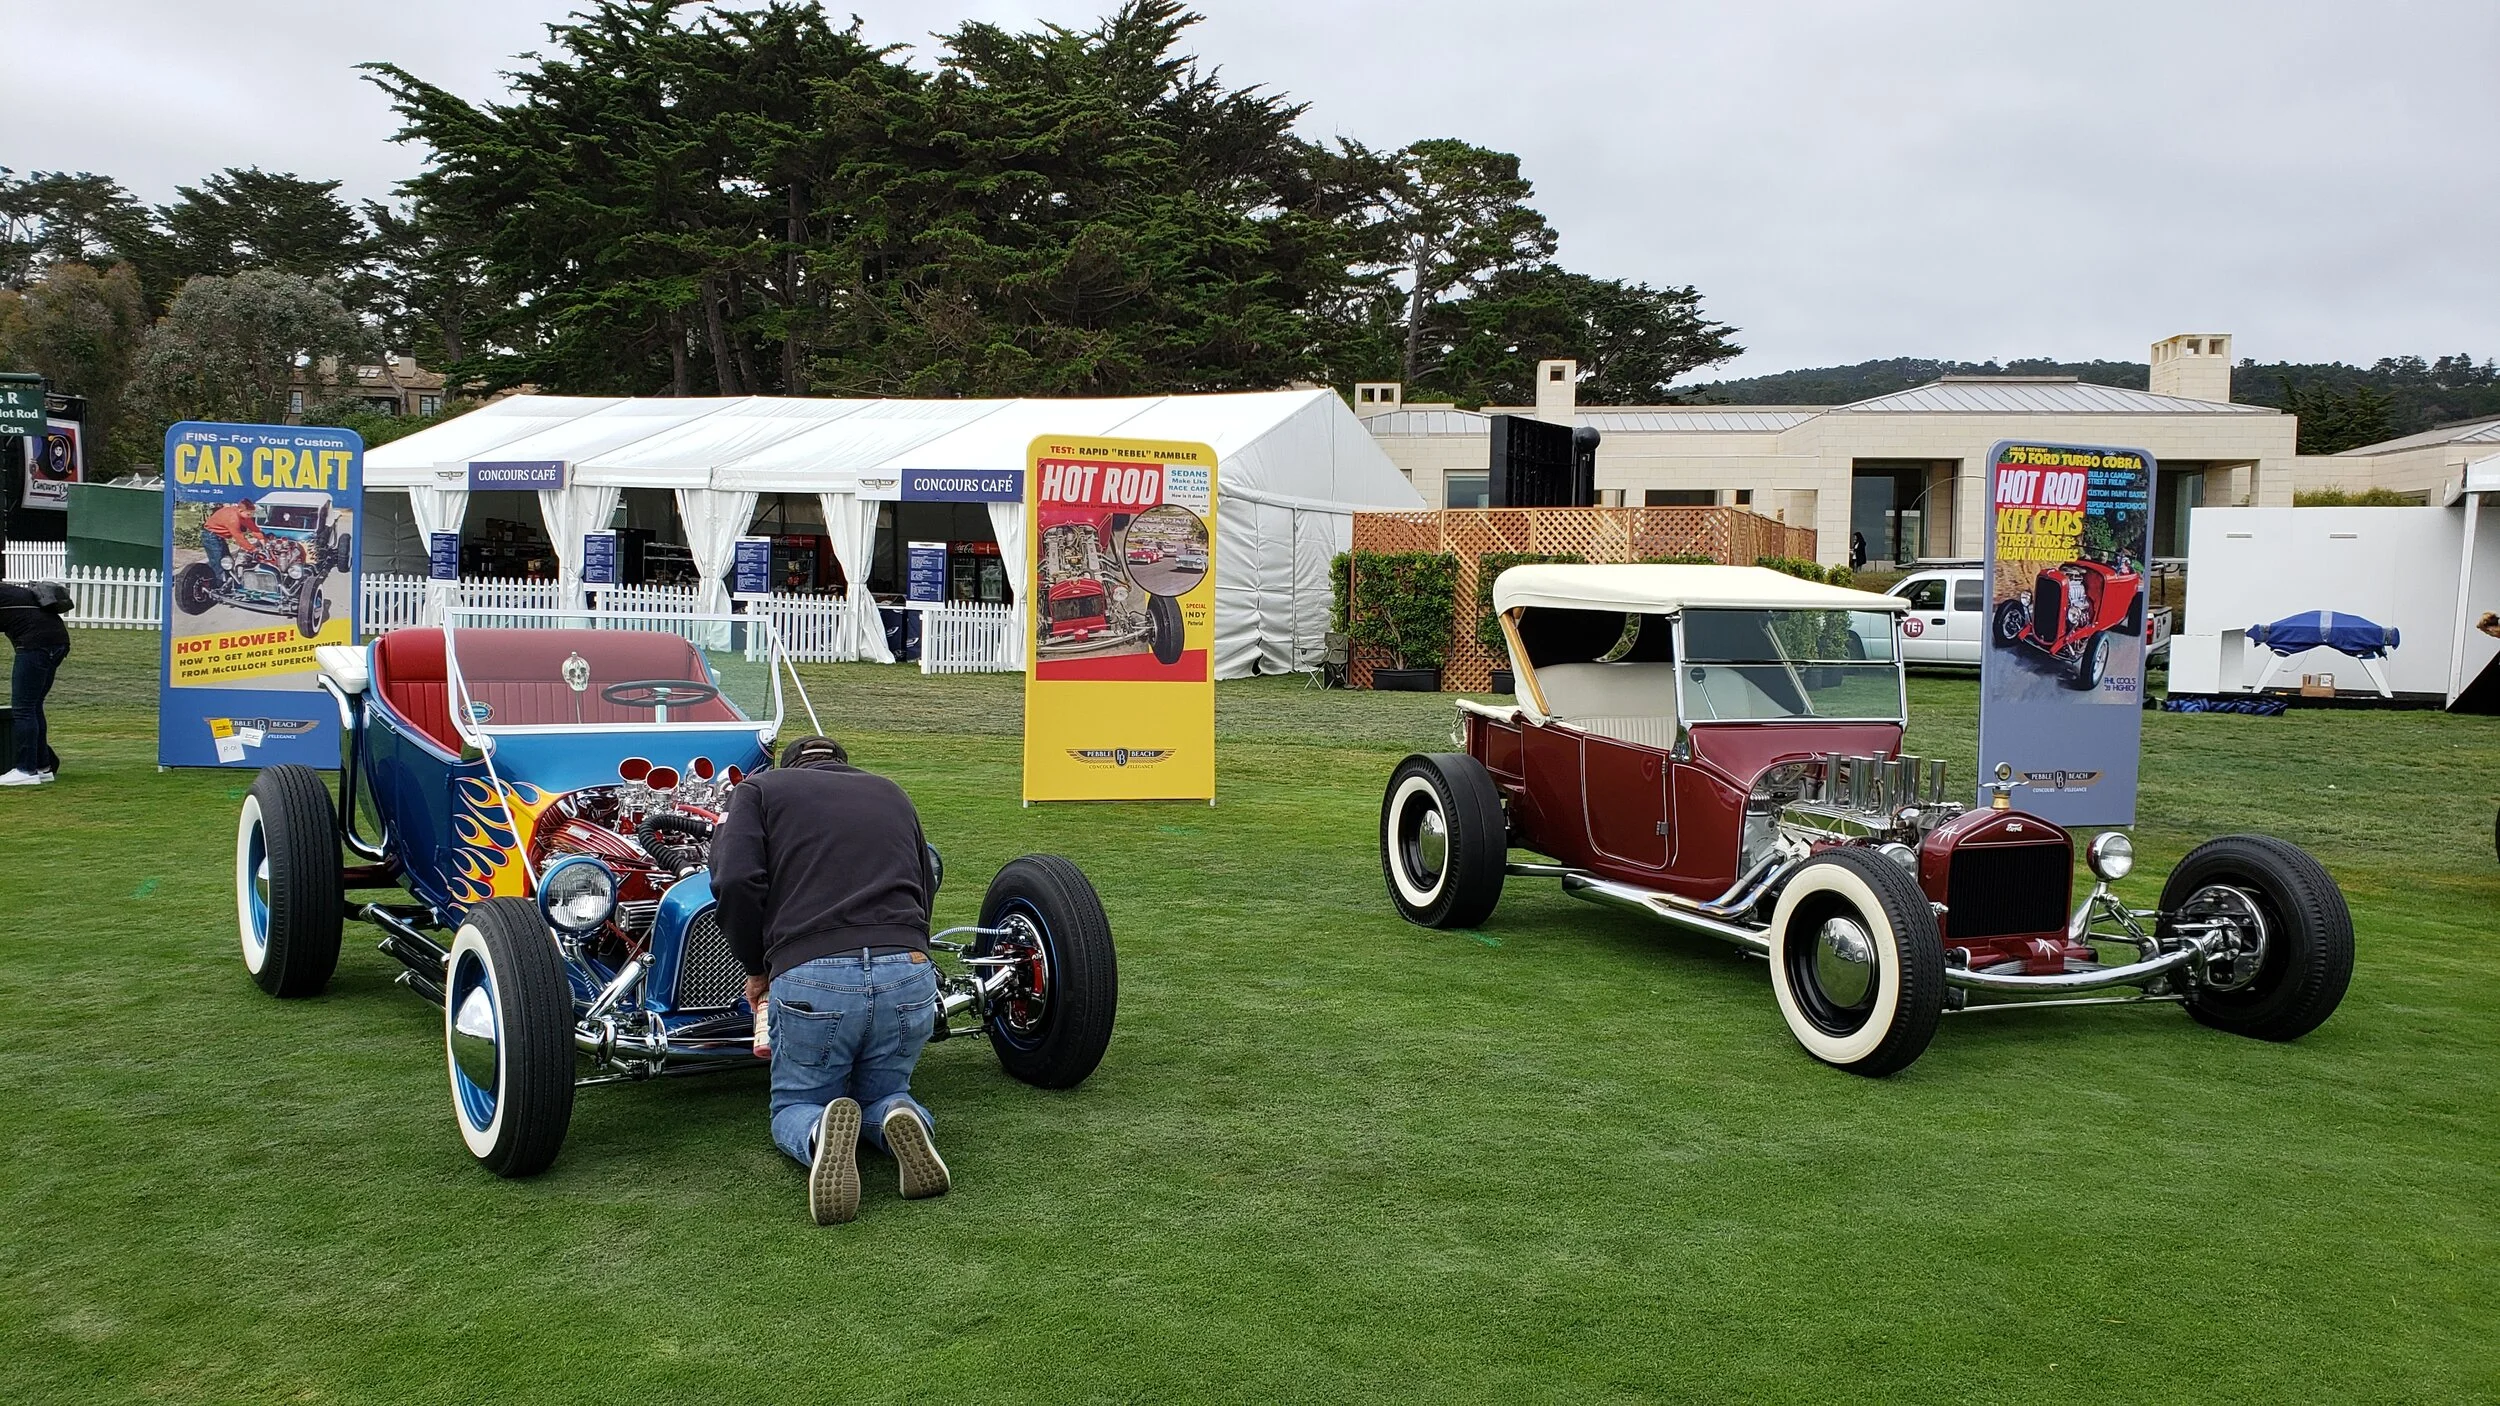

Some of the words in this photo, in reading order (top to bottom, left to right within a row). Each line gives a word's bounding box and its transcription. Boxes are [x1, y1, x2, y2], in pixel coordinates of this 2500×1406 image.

[7, 391, 19, 404] R
[17, 409, 38, 418] Rod
[0, 424, 24, 433] Cars
[186, 432, 217, 442] FINS
[232, 434, 254, 444] For
[259, 436, 290, 446] Your
[294, 437, 343, 448] Custom
[1050, 446, 1075, 454] TEST:
[1079, 448, 1109, 456] RAPID
[1112, 448, 1151, 458] "REBEL"
[1154, 451, 1197, 460] RAMBLER
[2009, 452, 2027, 464] '79
[2028, 453, 2060, 466] FORD
[2061, 454, 2101, 468] TURBO
[2102, 456, 2142, 470] COBRA
[174, 443, 244, 486] CAR
[252, 447, 353, 491] CRAFT
[478, 469, 529, 481] CONCOURS
[531, 465, 556, 480] CAFÉ
[914, 478, 979, 492] CONCOURS
[981, 474, 1013, 493] CAFÉ
[1042, 464, 1099, 503] HOT
[1102, 468, 1160, 505] ROD
[1996, 469, 2041, 504] HOT
[2041, 472, 2086, 506] ROD
[1996, 508, 2032, 534] KIT
[2033, 510, 2084, 536] CARS
[1997, 533, 2034, 547] STREET
[2034, 535, 2061, 548] RODS
[2062, 536, 2076, 549] &
[1996, 547, 2026, 560] MEAN
[2028, 548, 2080, 562] MACHINES
[177, 640, 212, 655] HOT
[219, 629, 295, 650] BLOWER!
[179, 657, 203, 667] HOW
[207, 655, 220, 663] TO
[224, 653, 242, 661] GET
[246, 649, 274, 659] MORE
[181, 668, 209, 678] FROM
[212, 661, 267, 675] McCULLOCH
[271, 656, 316, 667] SUPERCH
